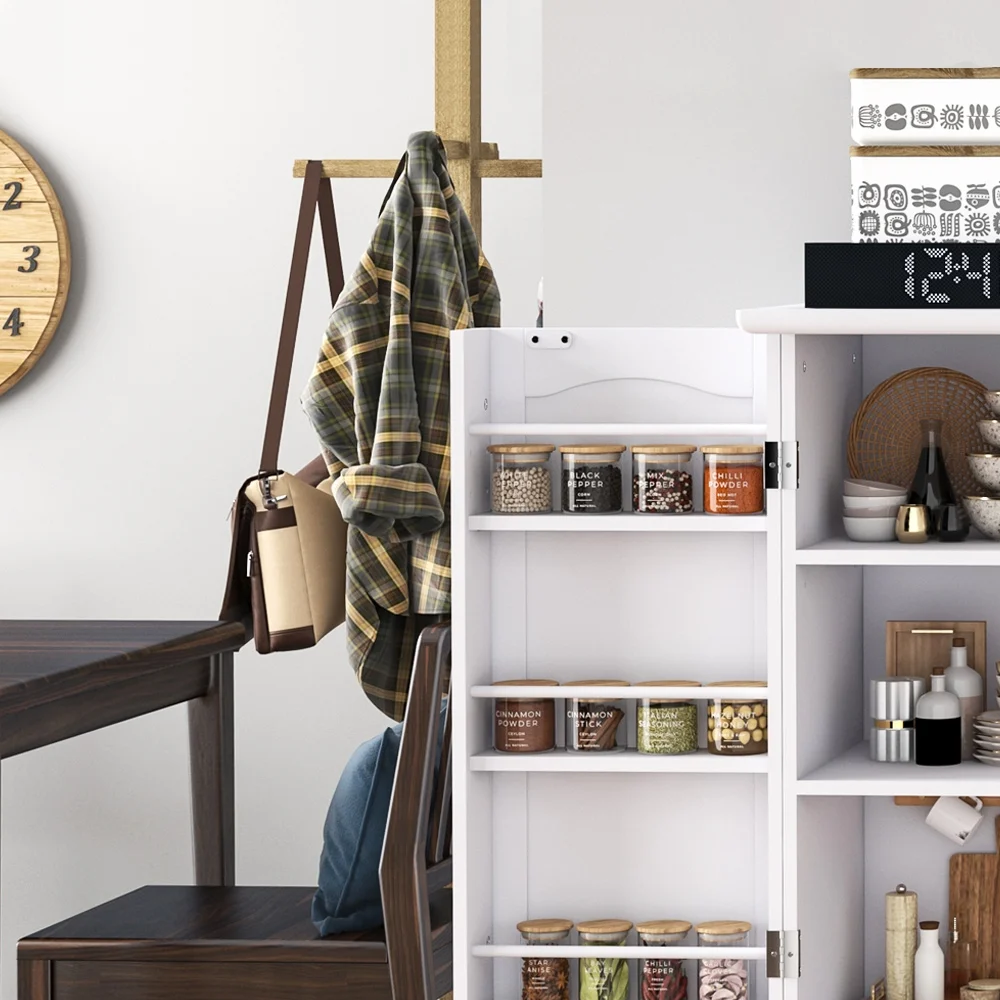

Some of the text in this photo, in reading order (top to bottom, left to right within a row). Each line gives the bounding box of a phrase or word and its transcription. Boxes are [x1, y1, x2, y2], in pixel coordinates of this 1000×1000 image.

[3, 181, 23, 211] 2
[17, 245, 41, 273] 3
[2, 307, 25, 337] 4
[567, 480, 603, 488] PEPPER
[708, 480, 749, 488] POWDER
[495, 711, 542, 719] CINNAMON
[567, 711, 613, 719] CINNAMON
[574, 720, 602, 728] STICK
